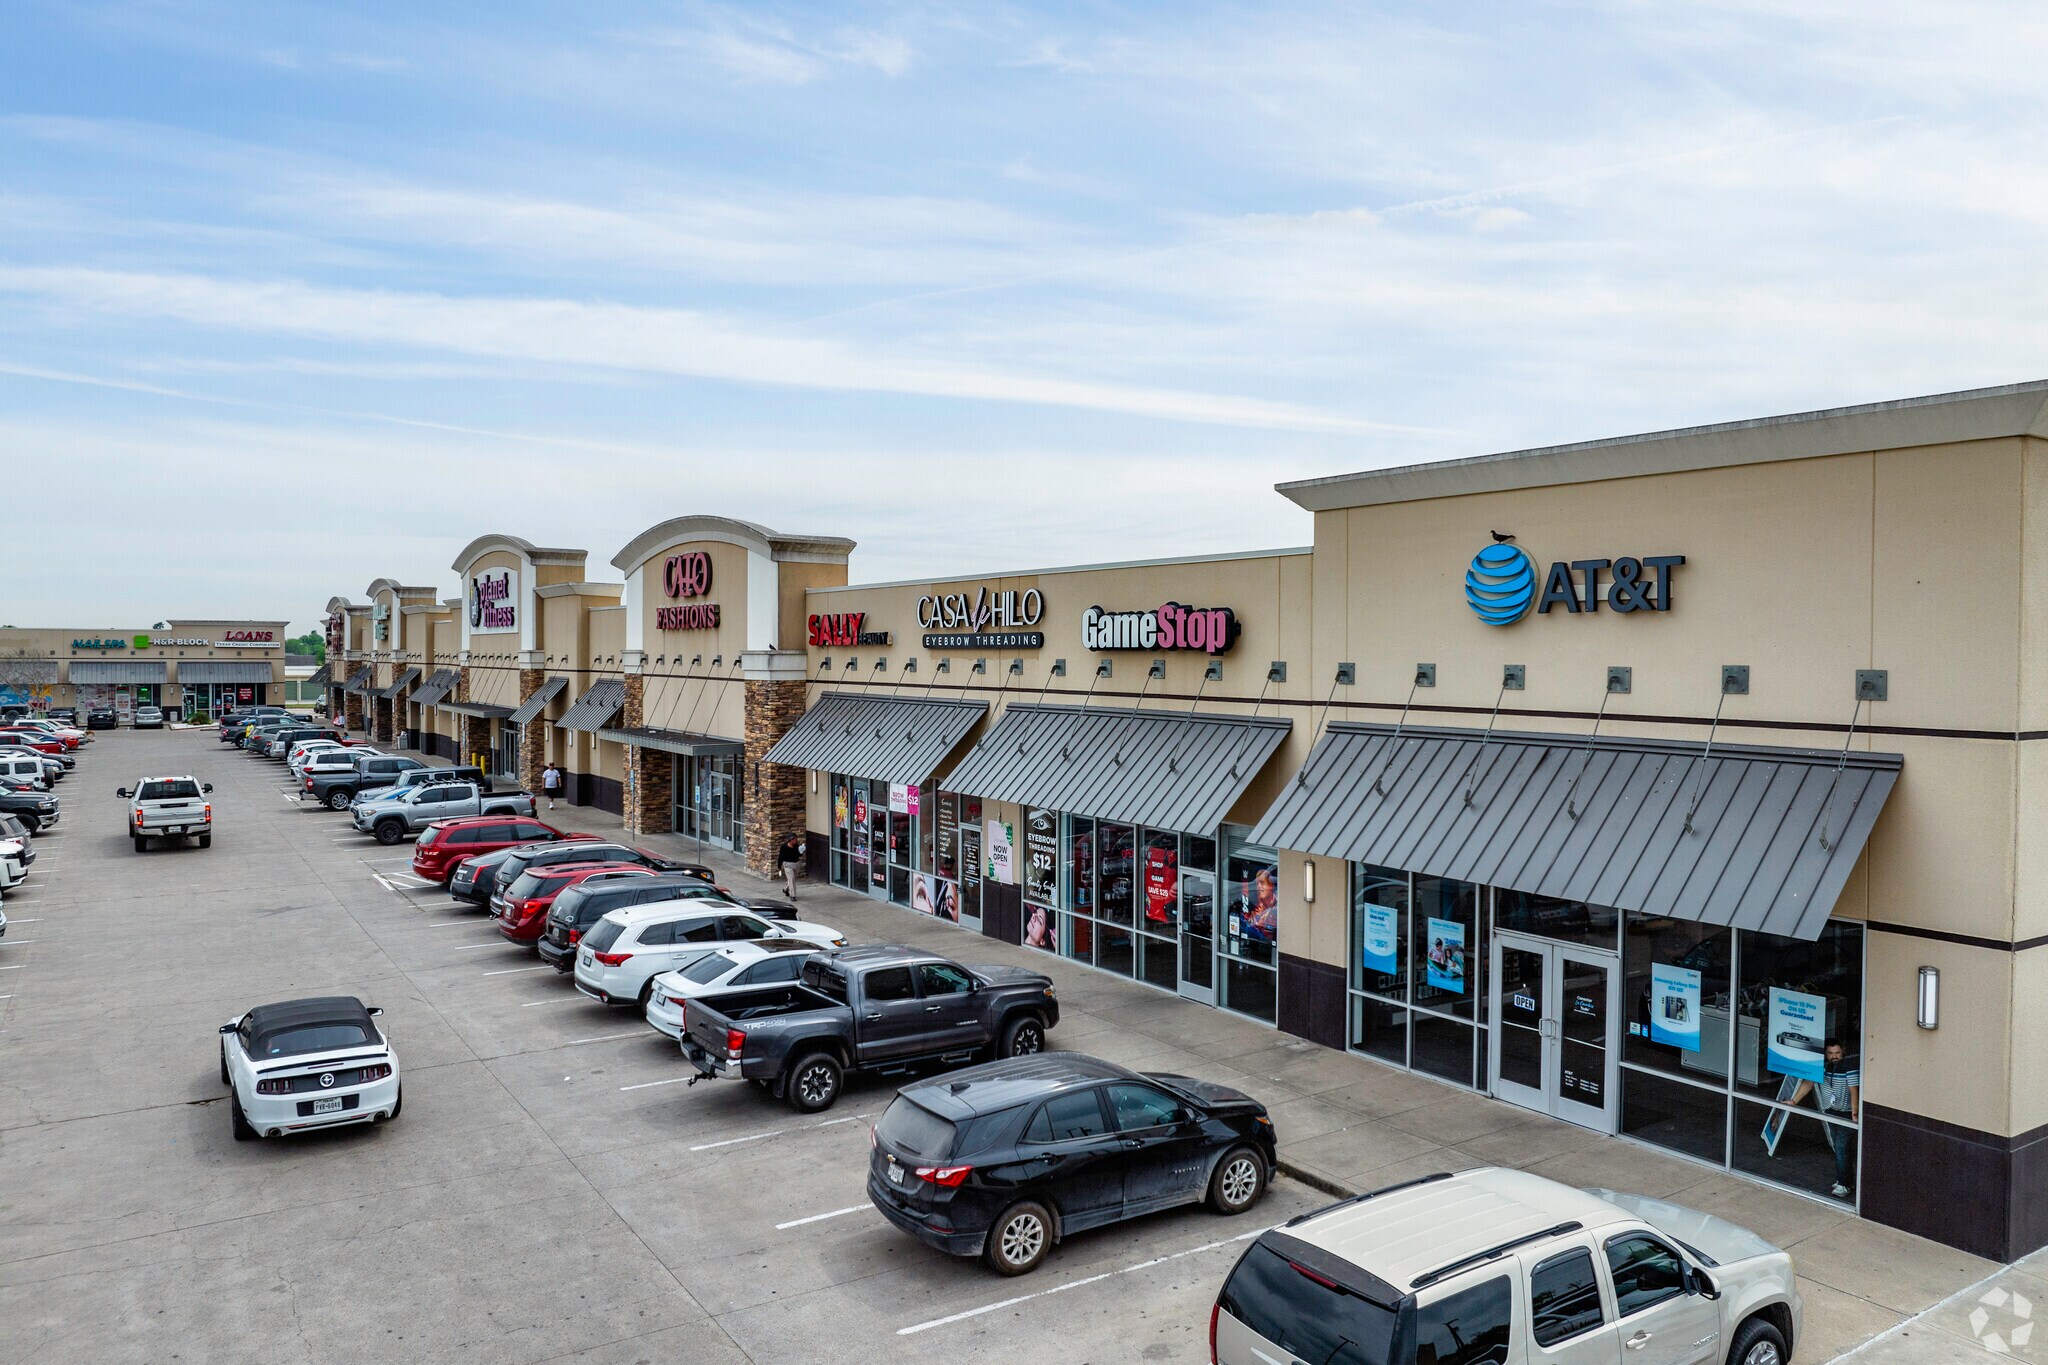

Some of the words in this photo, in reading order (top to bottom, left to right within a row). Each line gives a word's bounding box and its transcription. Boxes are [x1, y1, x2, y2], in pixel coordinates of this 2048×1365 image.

[663, 552, 713, 597] CATO
[480, 572, 509, 608] planet
[1538, 555, 1686, 613] AT&T
[484, 600, 514, 627] fitness
[917, 593, 973, 628] CASA
[992, 588, 1044, 627] HILO
[656, 605, 720, 629] FASHIONS
[808, 613, 865, 646] SALLY
[859, 632, 890, 645] BEAUTY
[1082, 601, 1235, 655] GameStop
[153, 638, 175, 646] H&R
[177, 638, 209, 646] BLOCK
[225, 631, 273, 641] LOANS
[925, 636, 970, 646] EYEBROW
[976, 635, 1037, 646] THREADING
[72, 639, 103, 649] NAIL
[104, 639, 127, 649] SPA
[908, 794, 919, 805] $12
[1027, 832, 1057, 846] EYEBROW
[993, 844, 1008, 854] NOW
[1028, 842, 1055, 854] THREADING
[992, 853, 1008, 862] OPEN
[1033, 852, 1051, 870] $12
[1147, 886, 1159, 895] SAVE
[1515, 996, 1534, 1009] OPEN
[1778, 997, 1798, 1007] iPhone
[1805, 1002, 1817, 1010] Pro
[1780, 1009, 1815, 1022] Guaranteed
[744, 1022, 767, 1030] TRD
